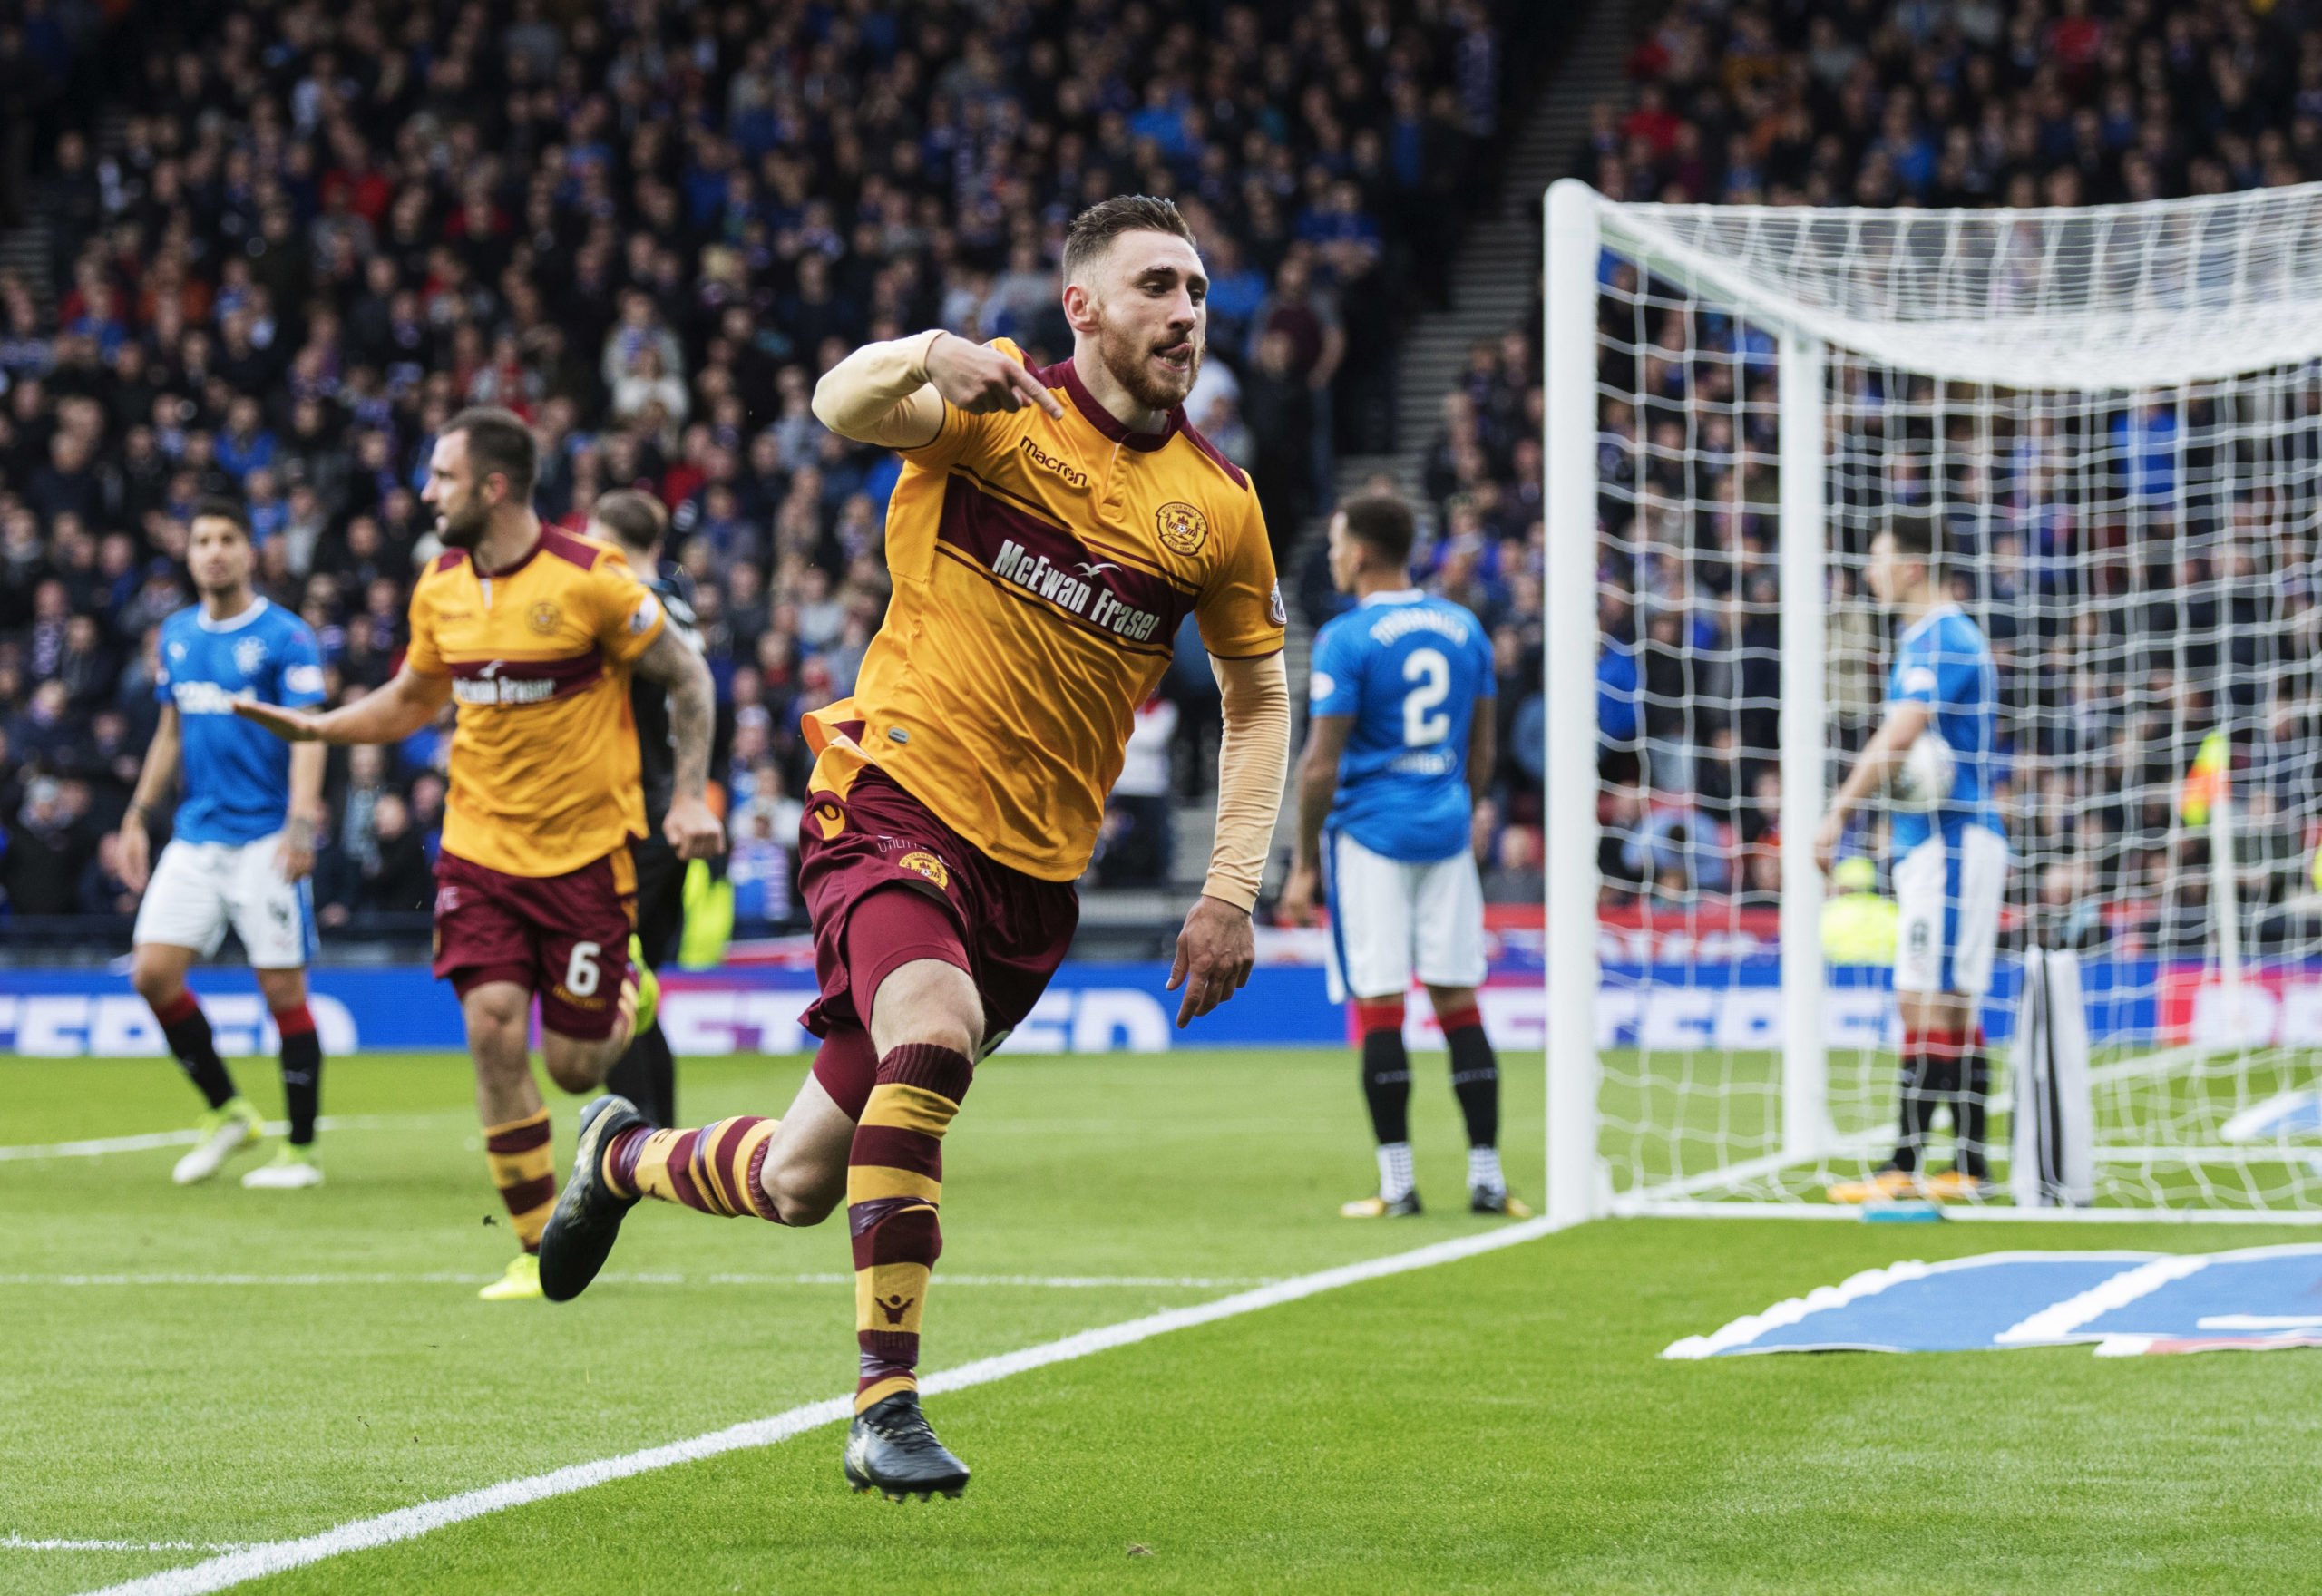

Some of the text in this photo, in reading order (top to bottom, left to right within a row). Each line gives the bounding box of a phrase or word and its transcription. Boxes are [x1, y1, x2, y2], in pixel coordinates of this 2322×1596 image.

[1020, 435, 1088, 487] macron
[991, 539, 1161, 642] McEwan Fraser
[1402, 647, 1450, 747] 2
[565, 941, 600, 996] 6
